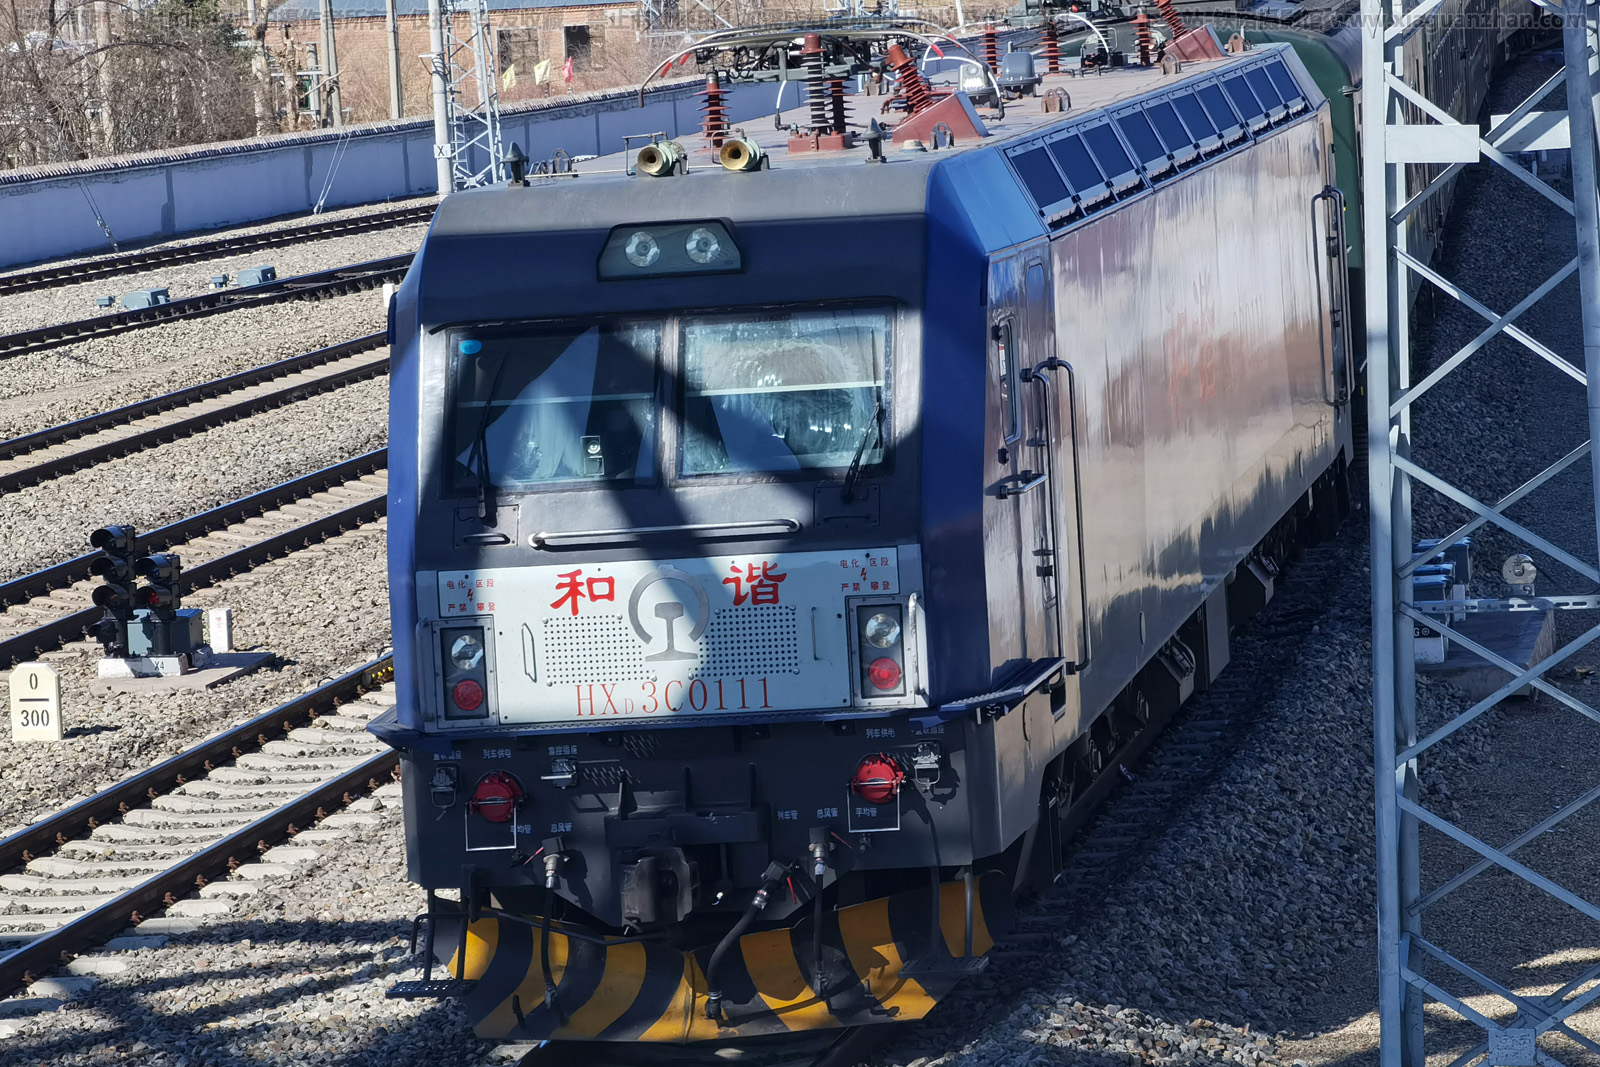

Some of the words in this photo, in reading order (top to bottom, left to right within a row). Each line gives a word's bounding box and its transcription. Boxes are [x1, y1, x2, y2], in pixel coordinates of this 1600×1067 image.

[549, 568, 616, 617] 和
[721, 560, 788, 607] 谐
[29, 672, 39, 691] 0
[20, 709, 50, 727] 300
